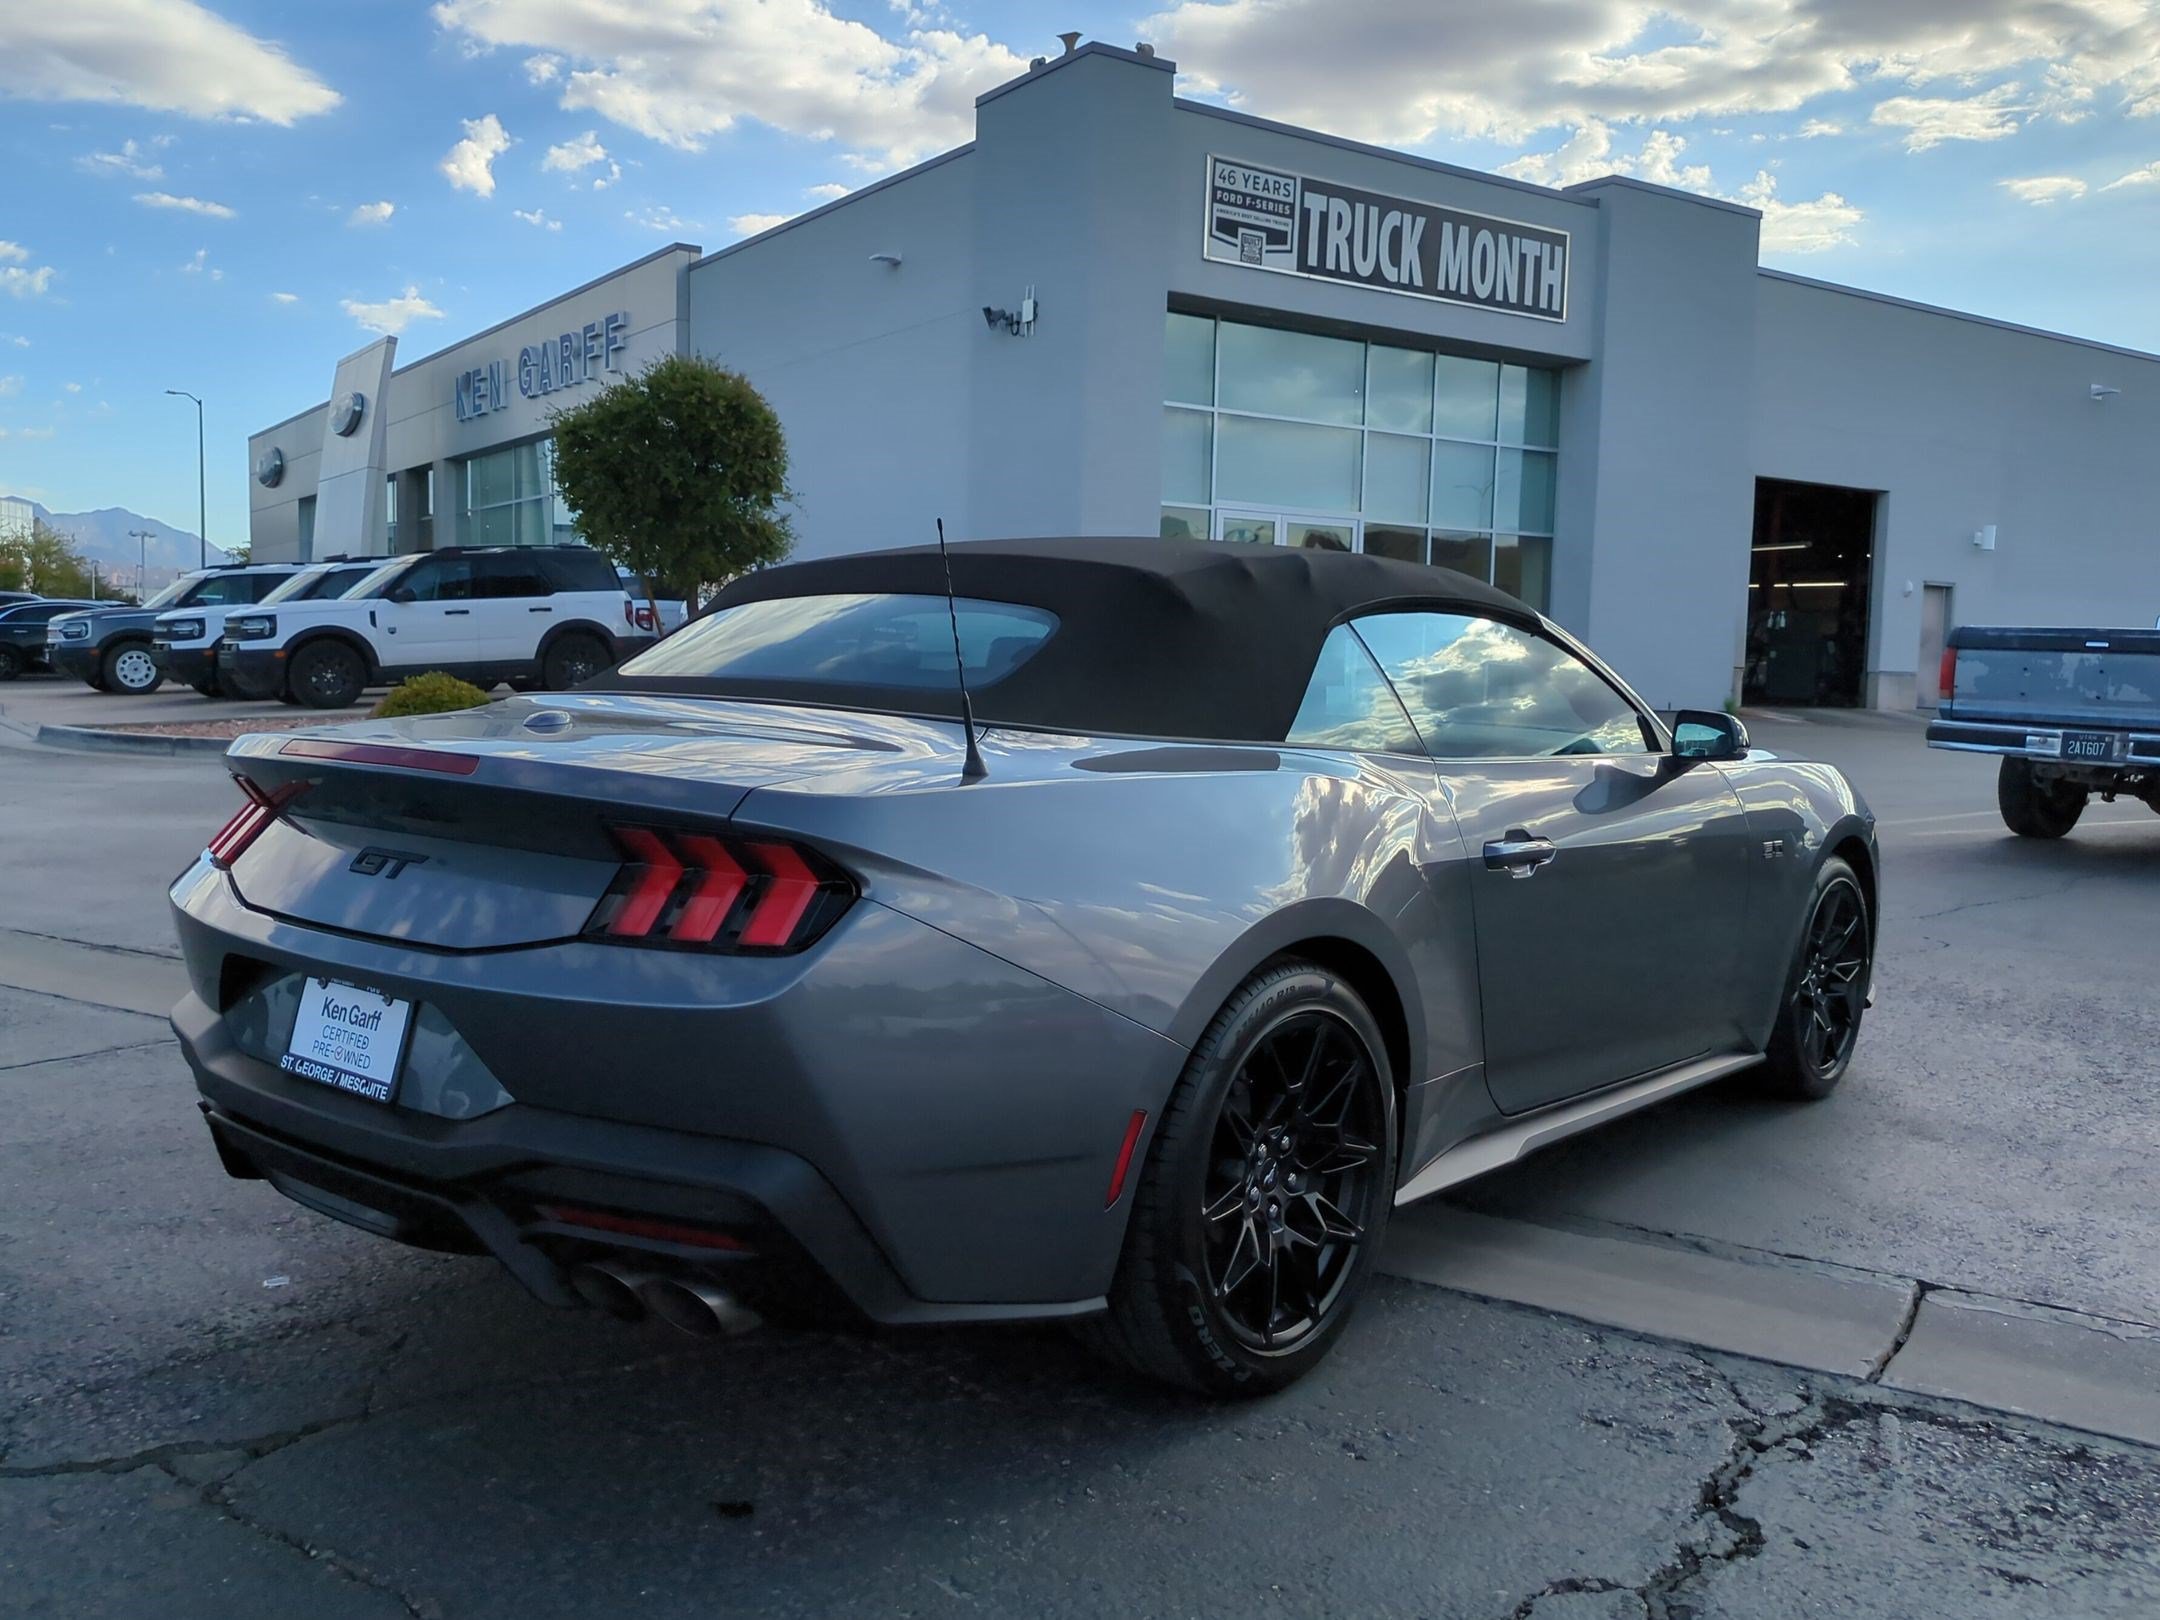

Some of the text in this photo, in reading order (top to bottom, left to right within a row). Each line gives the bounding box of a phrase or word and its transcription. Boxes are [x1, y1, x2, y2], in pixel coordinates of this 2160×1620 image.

[1216, 190, 1243, 205] FORD
[1218, 168, 1291, 198] 46 YEARS
[1304, 191, 1563, 312] TRUCK MONTH
[455, 311, 627, 421] KEN GARFF
[2067, 740, 2106, 756] 2AT607
[349, 846, 430, 879] GT
[321, 996, 382, 1031] Ken Garff
[322, 1025, 370, 1050] CERTIFIED
[280, 1055, 294, 1069] ST.
[295, 1059, 334, 1083] GEORGE
[339, 1072, 389, 1100] MESQUITE
